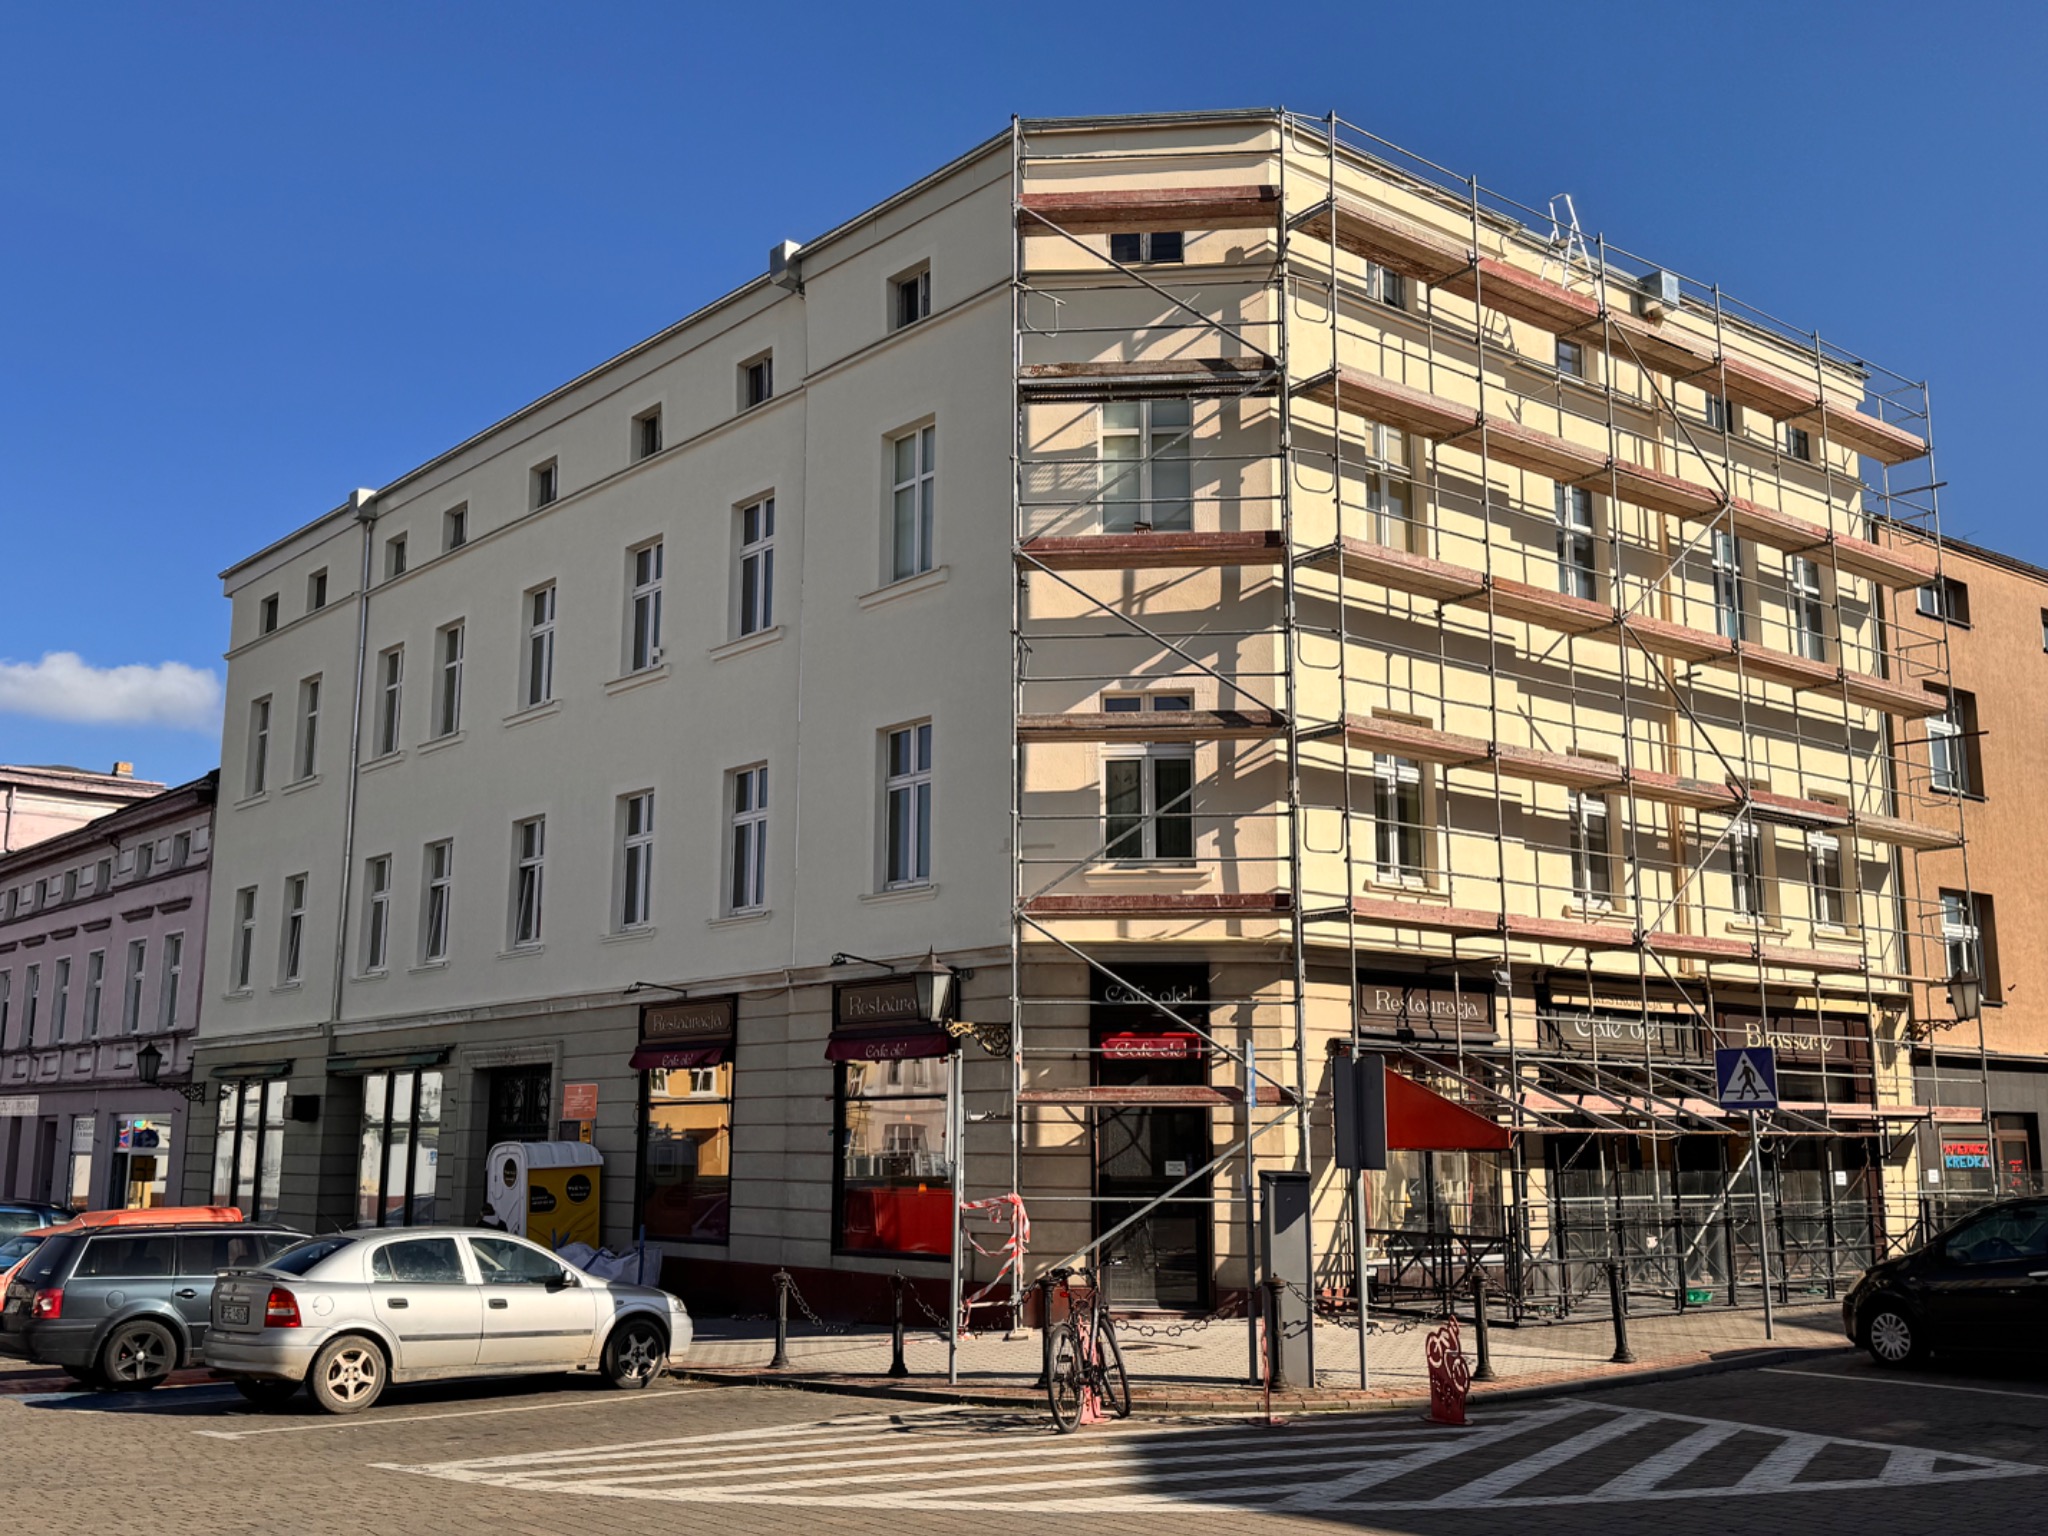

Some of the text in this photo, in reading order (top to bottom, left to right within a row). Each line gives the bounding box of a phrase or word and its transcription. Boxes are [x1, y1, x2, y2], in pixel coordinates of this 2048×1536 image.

[848, 996, 917, 1016] Restaura
[652, 1010, 722, 1031] Restauracja
[1945, 1155, 1991, 1168] KREDKA
